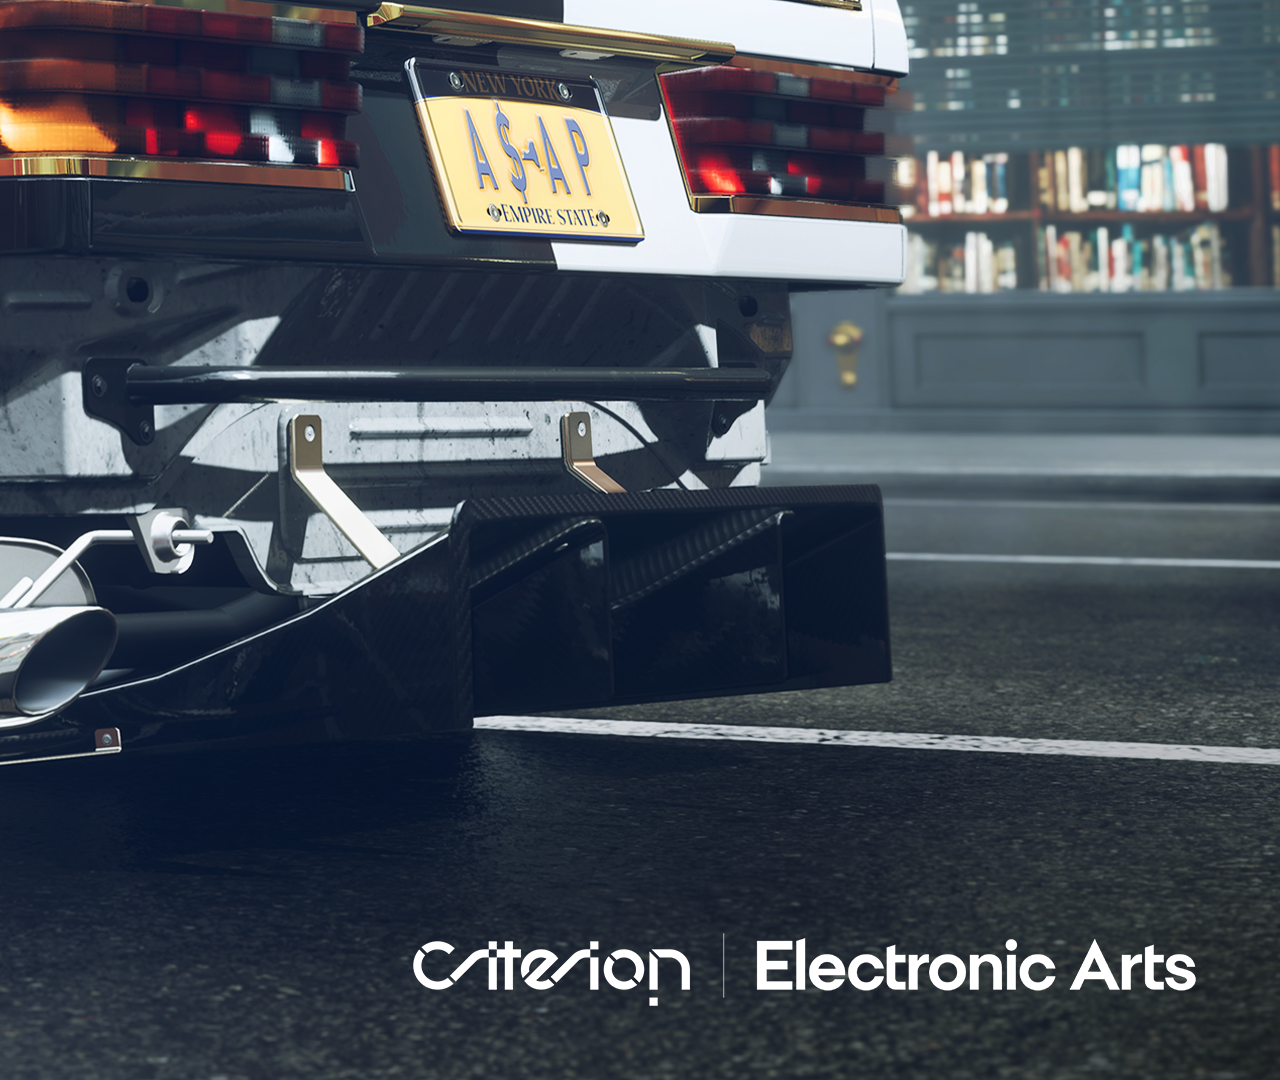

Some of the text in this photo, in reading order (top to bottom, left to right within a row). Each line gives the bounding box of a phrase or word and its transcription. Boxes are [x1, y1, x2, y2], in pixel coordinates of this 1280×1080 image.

[459, 69, 562, 102] NEW YORK
[499, 203, 598, 228] EMPIRE STATE
